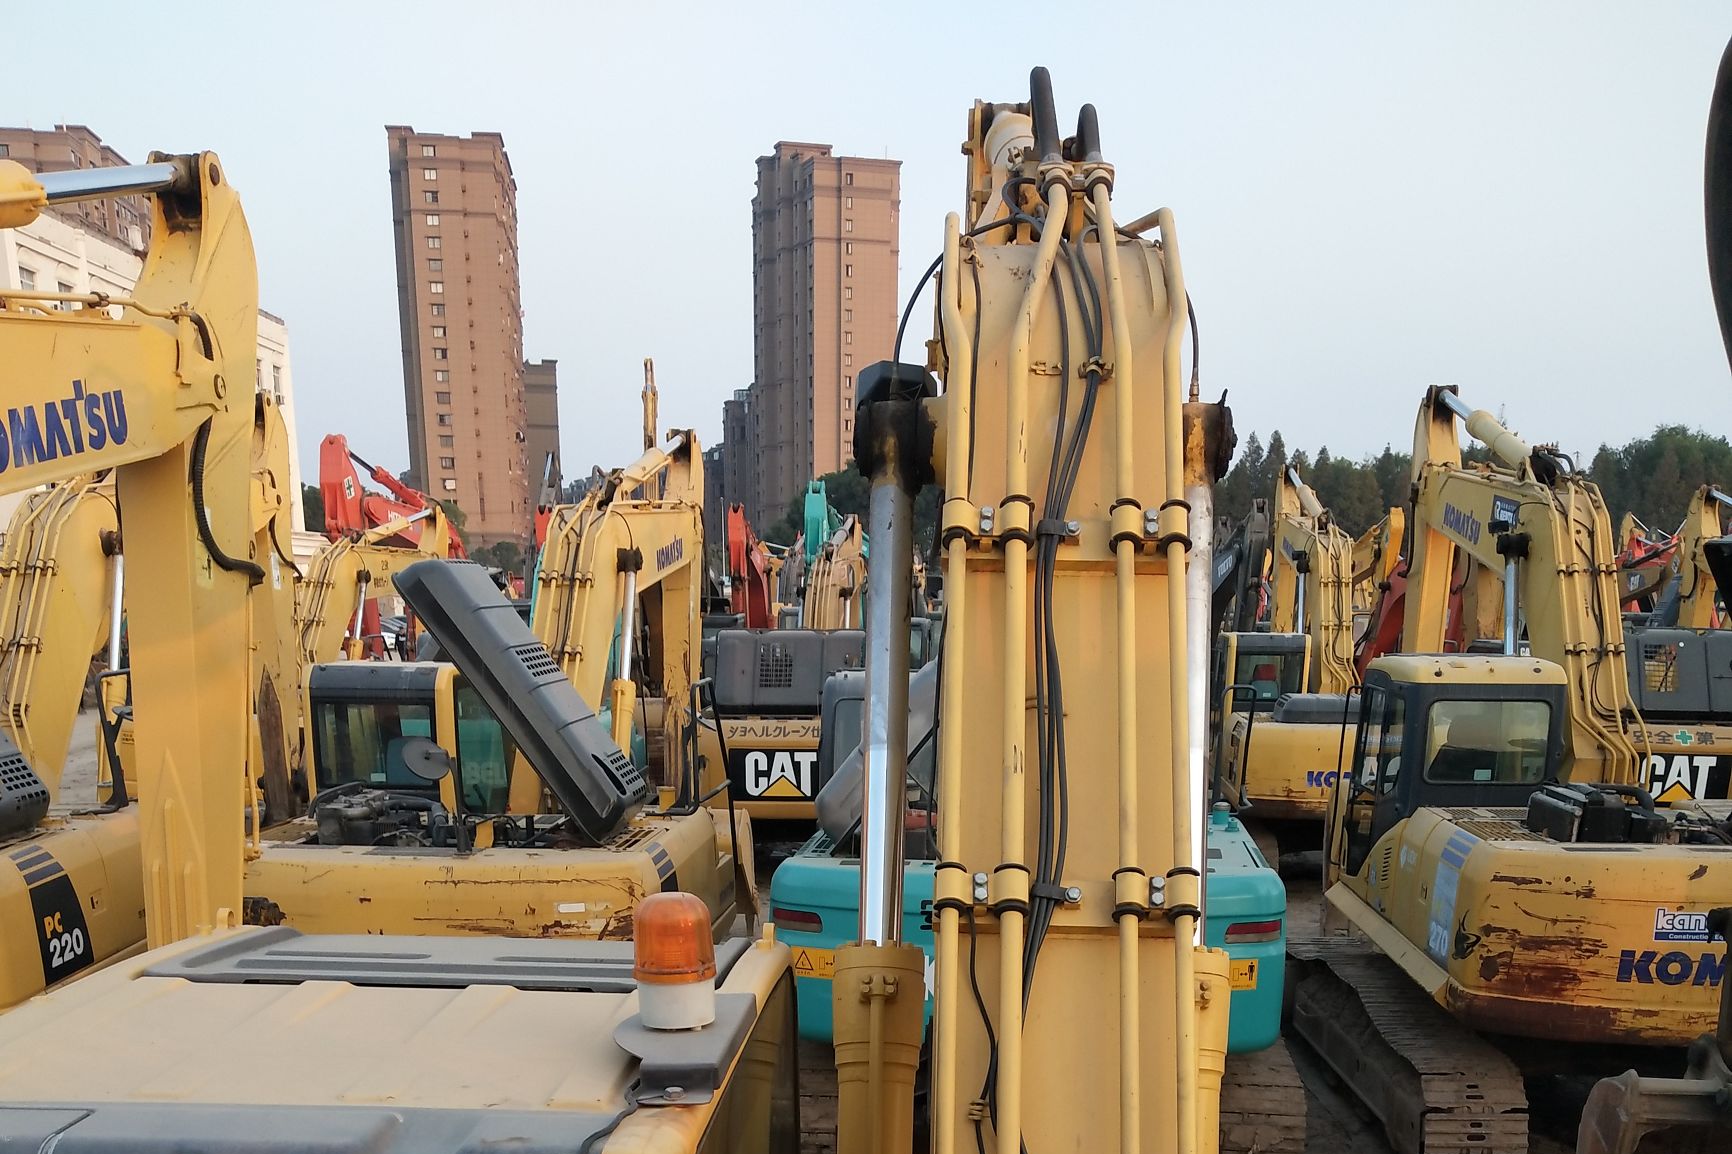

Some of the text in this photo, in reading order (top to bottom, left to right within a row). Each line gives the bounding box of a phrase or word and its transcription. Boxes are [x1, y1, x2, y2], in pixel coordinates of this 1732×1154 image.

[1443, 502, 1480, 545] KOMATSU
[656, 535, 682, 572] KOMATSU
[745, 751, 818, 797] CAT
[1640, 755, 1717, 800] CAT
[44, 911, 63, 939] PC
[1428, 921, 1449, 957] 270
[49, 927, 84, 969] 220
